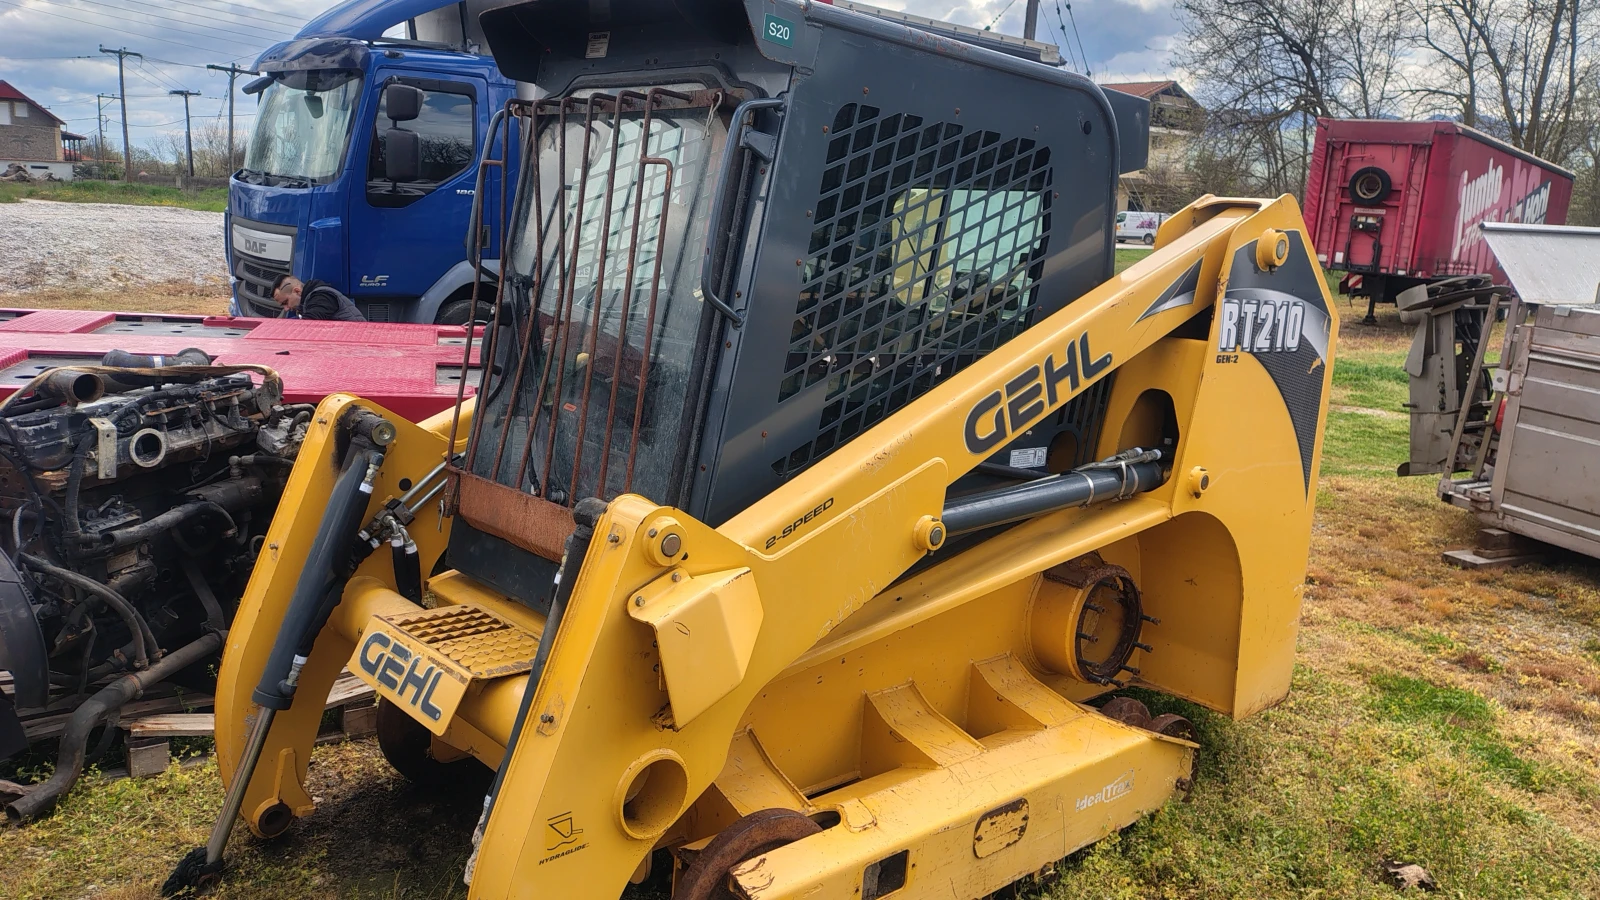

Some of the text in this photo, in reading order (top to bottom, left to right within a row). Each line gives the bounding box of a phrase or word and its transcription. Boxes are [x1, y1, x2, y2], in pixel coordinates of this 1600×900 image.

[768, 21, 791, 41] S20
[1452, 157, 1503, 261] jumbo
[244, 238, 267, 254] DAF
[361, 275, 390, 283] LF
[1218, 298, 1306, 353] RT210
[1216, 354, 1239, 364] GEN:2
[963, 329, 1114, 456] GEHL
[765, 496, 835, 550] 2-SPEED
[359, 630, 443, 722] GEHL
